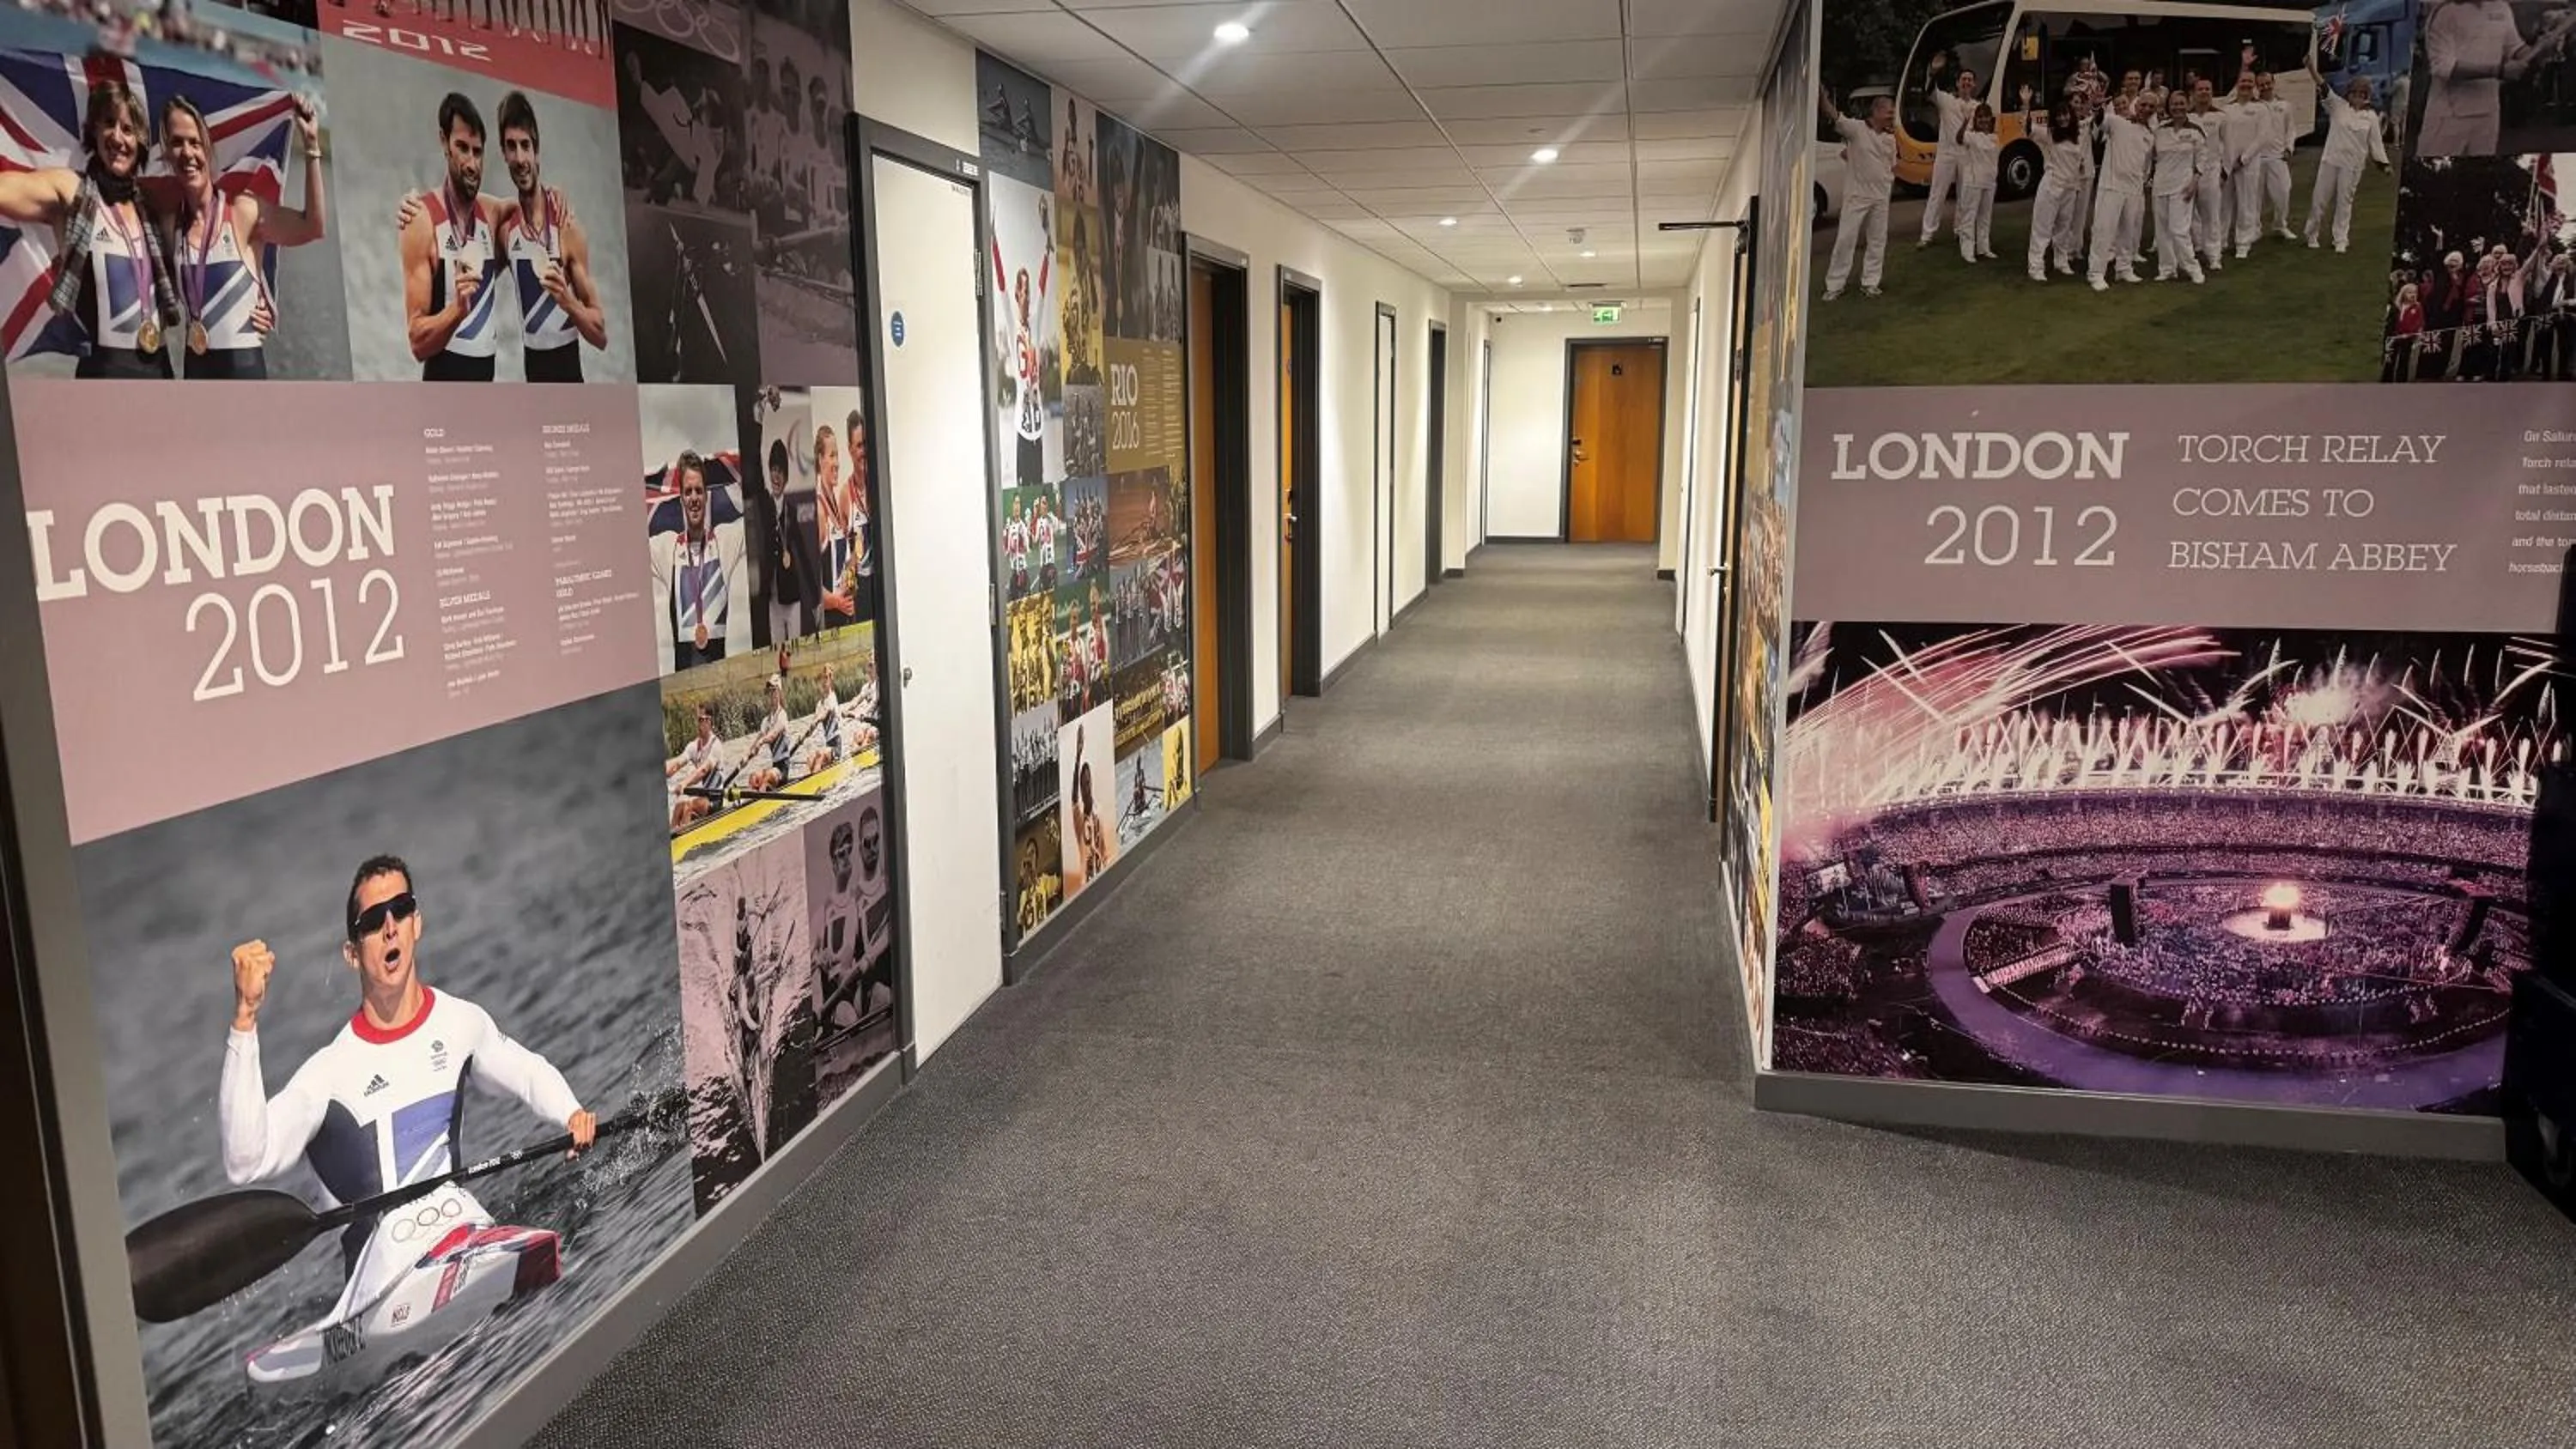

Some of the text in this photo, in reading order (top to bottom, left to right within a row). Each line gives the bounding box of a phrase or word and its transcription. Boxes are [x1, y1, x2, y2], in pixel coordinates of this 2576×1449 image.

[343, 19, 493, 63] 2012
[1110, 363, 1139, 406] RIO
[1112, 411, 1140, 451] 2016
[2178, 434, 2446, 464] TORCH RELAY
[1832, 431, 2130, 480] LONDON
[2172, 488, 2375, 518] COMES TO
[26, 484, 394, 602] LONDON
[1923, 505, 2118, 566] 2012
[2167, 541, 2458, 572] BISHAM ABBEY
[185, 568, 404, 701] 2012
